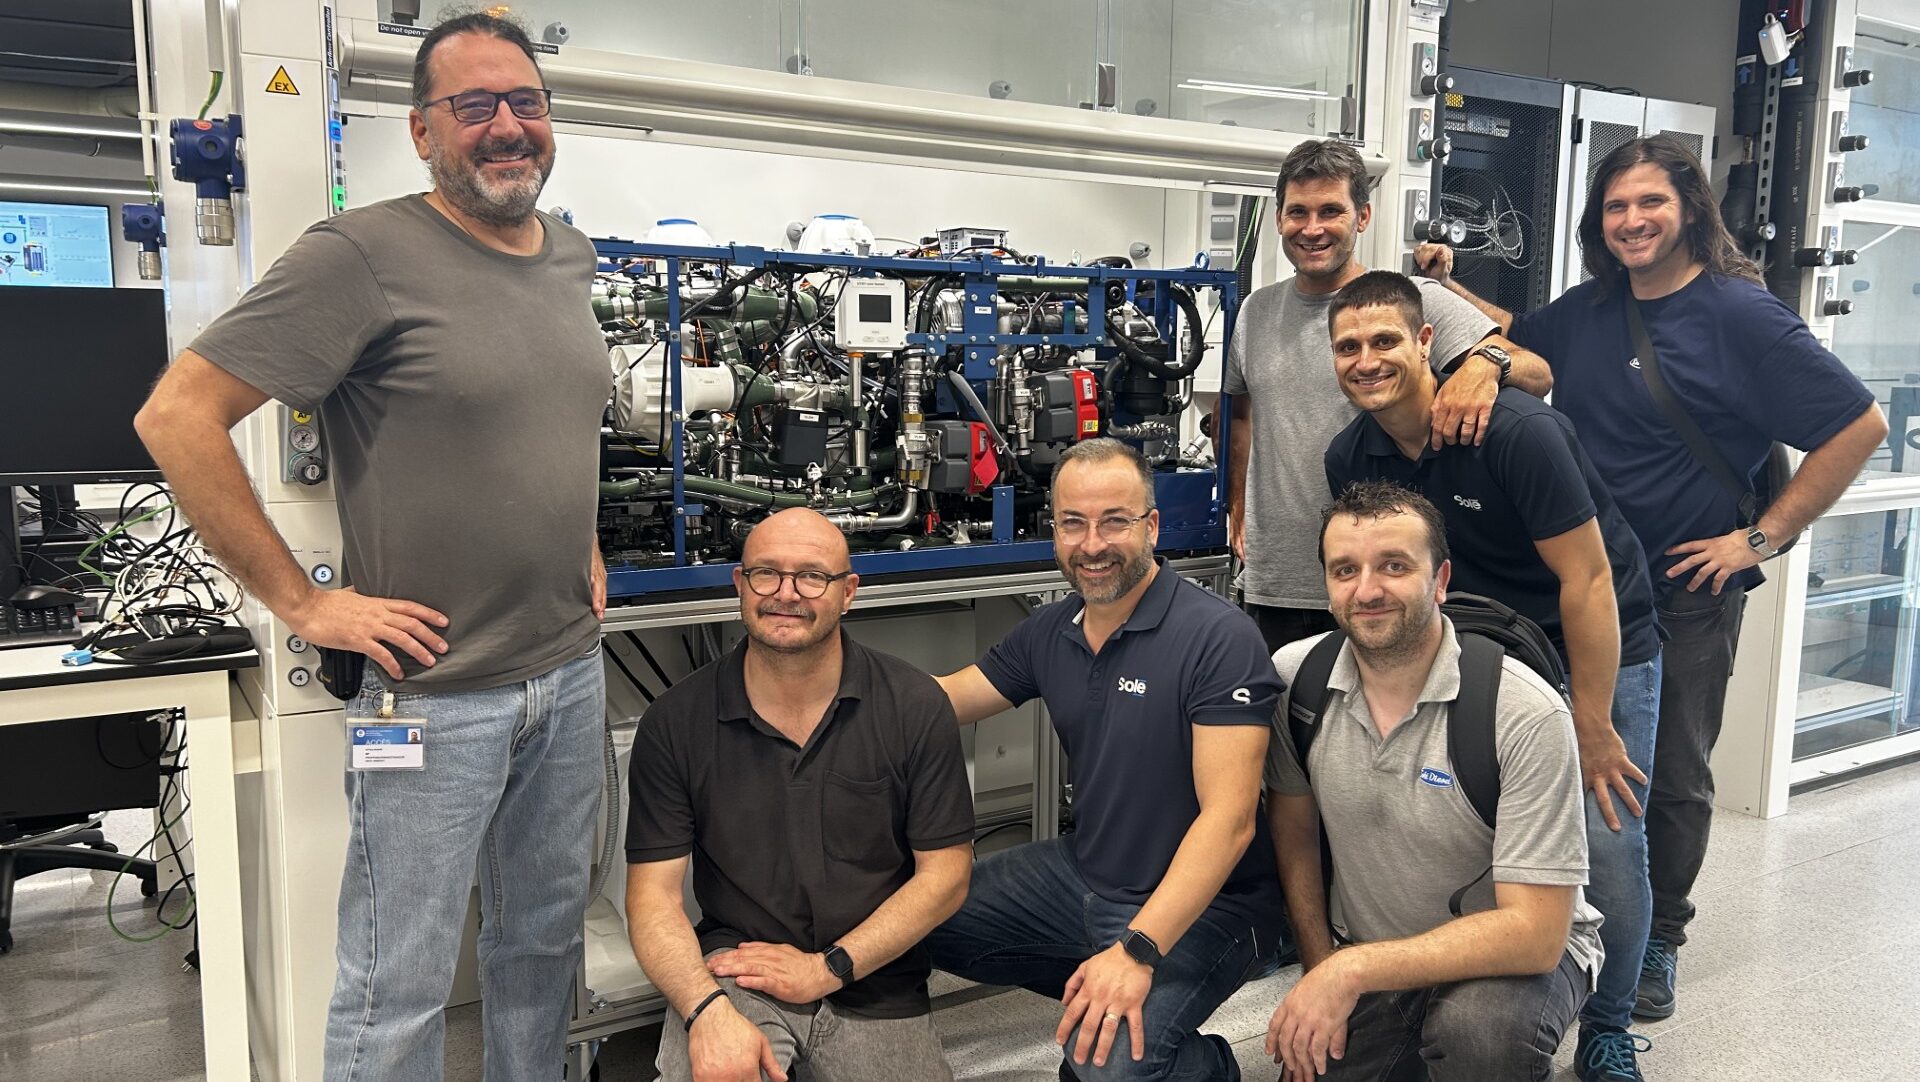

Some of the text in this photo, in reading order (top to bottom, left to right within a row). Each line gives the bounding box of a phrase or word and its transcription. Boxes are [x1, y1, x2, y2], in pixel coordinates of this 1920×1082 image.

[275, 82, 289, 91] EX
[320, 570, 327, 578] 5
[295, 640, 302, 648] 3
[296, 674, 304, 682] 4
